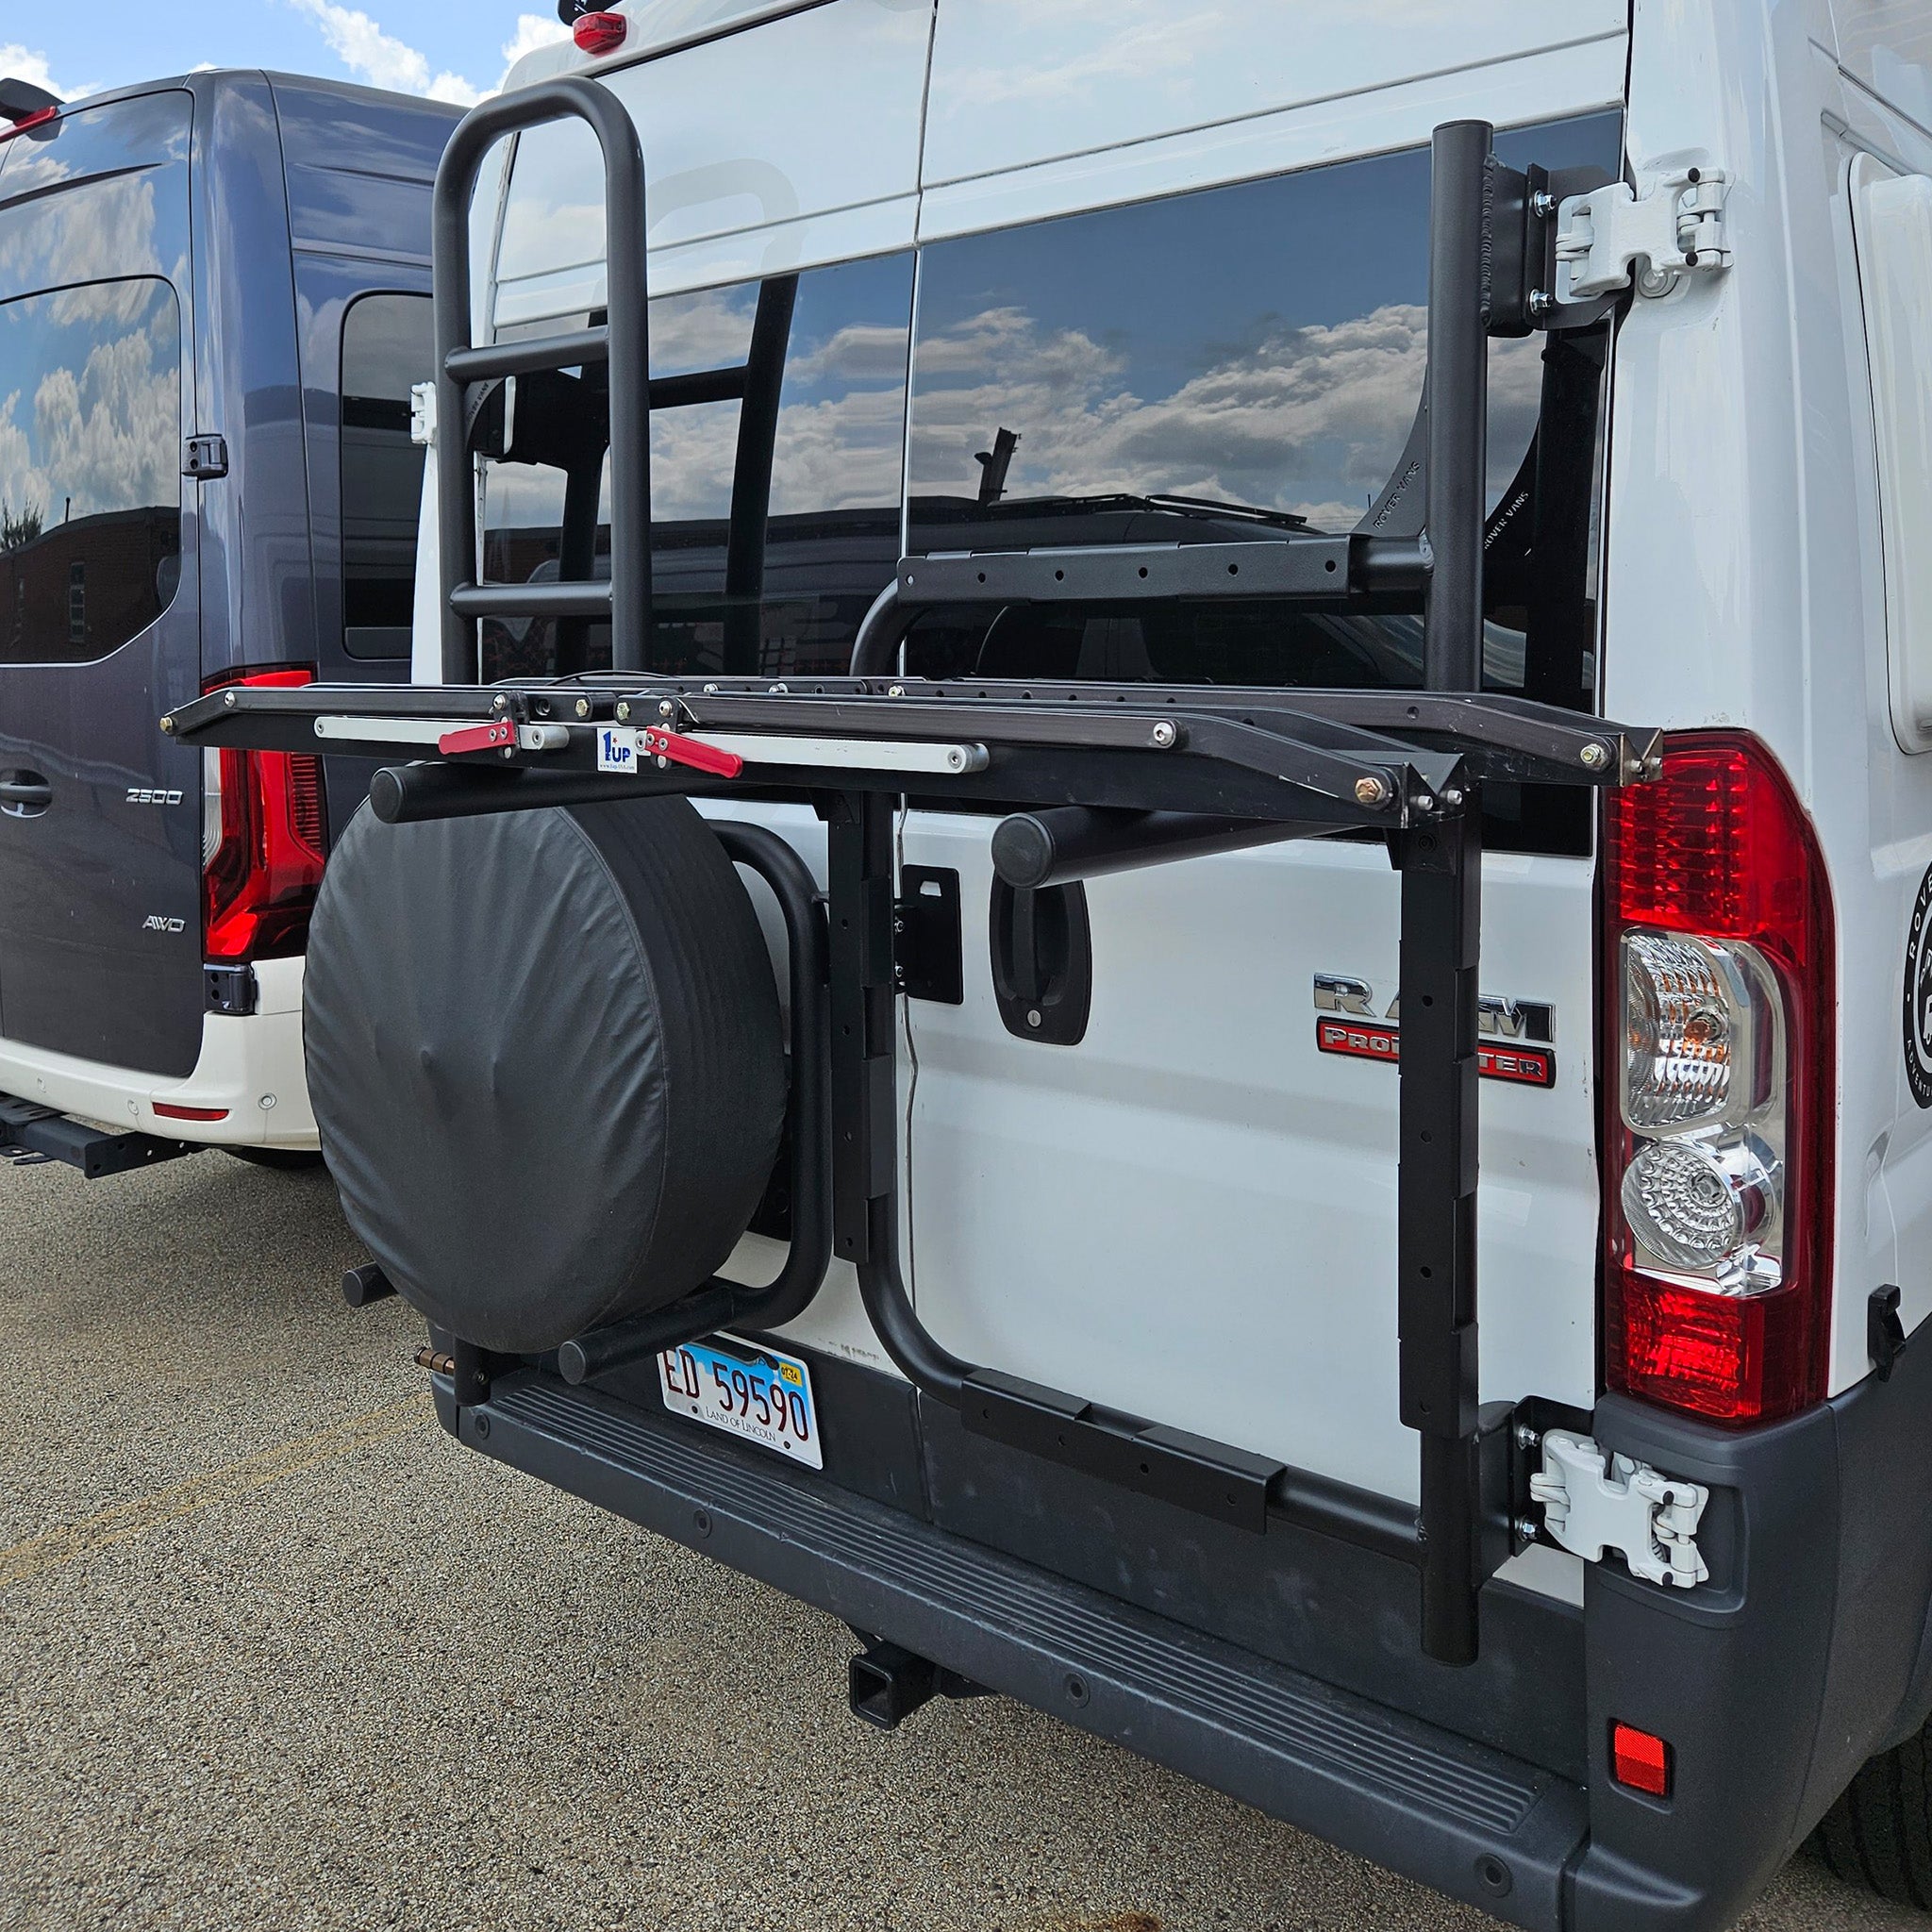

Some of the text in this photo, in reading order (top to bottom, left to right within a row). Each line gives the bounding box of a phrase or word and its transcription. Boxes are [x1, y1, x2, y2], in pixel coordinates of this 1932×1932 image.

[1373, 459, 1421, 530] ROVER VANS
[1505, 491, 1530, 518] VANS
[125, 788, 183, 806] 2500
[142, 915, 186, 933] AWD
[1313, 972, 1556, 1042] RM
[1324, 1026, 1543, 1076] PROTER
[662, 1348, 808, 1441] ED 59590
[706, 1406, 729, 1424] LAND
[741, 1419, 776, 1441] LINCOLN
